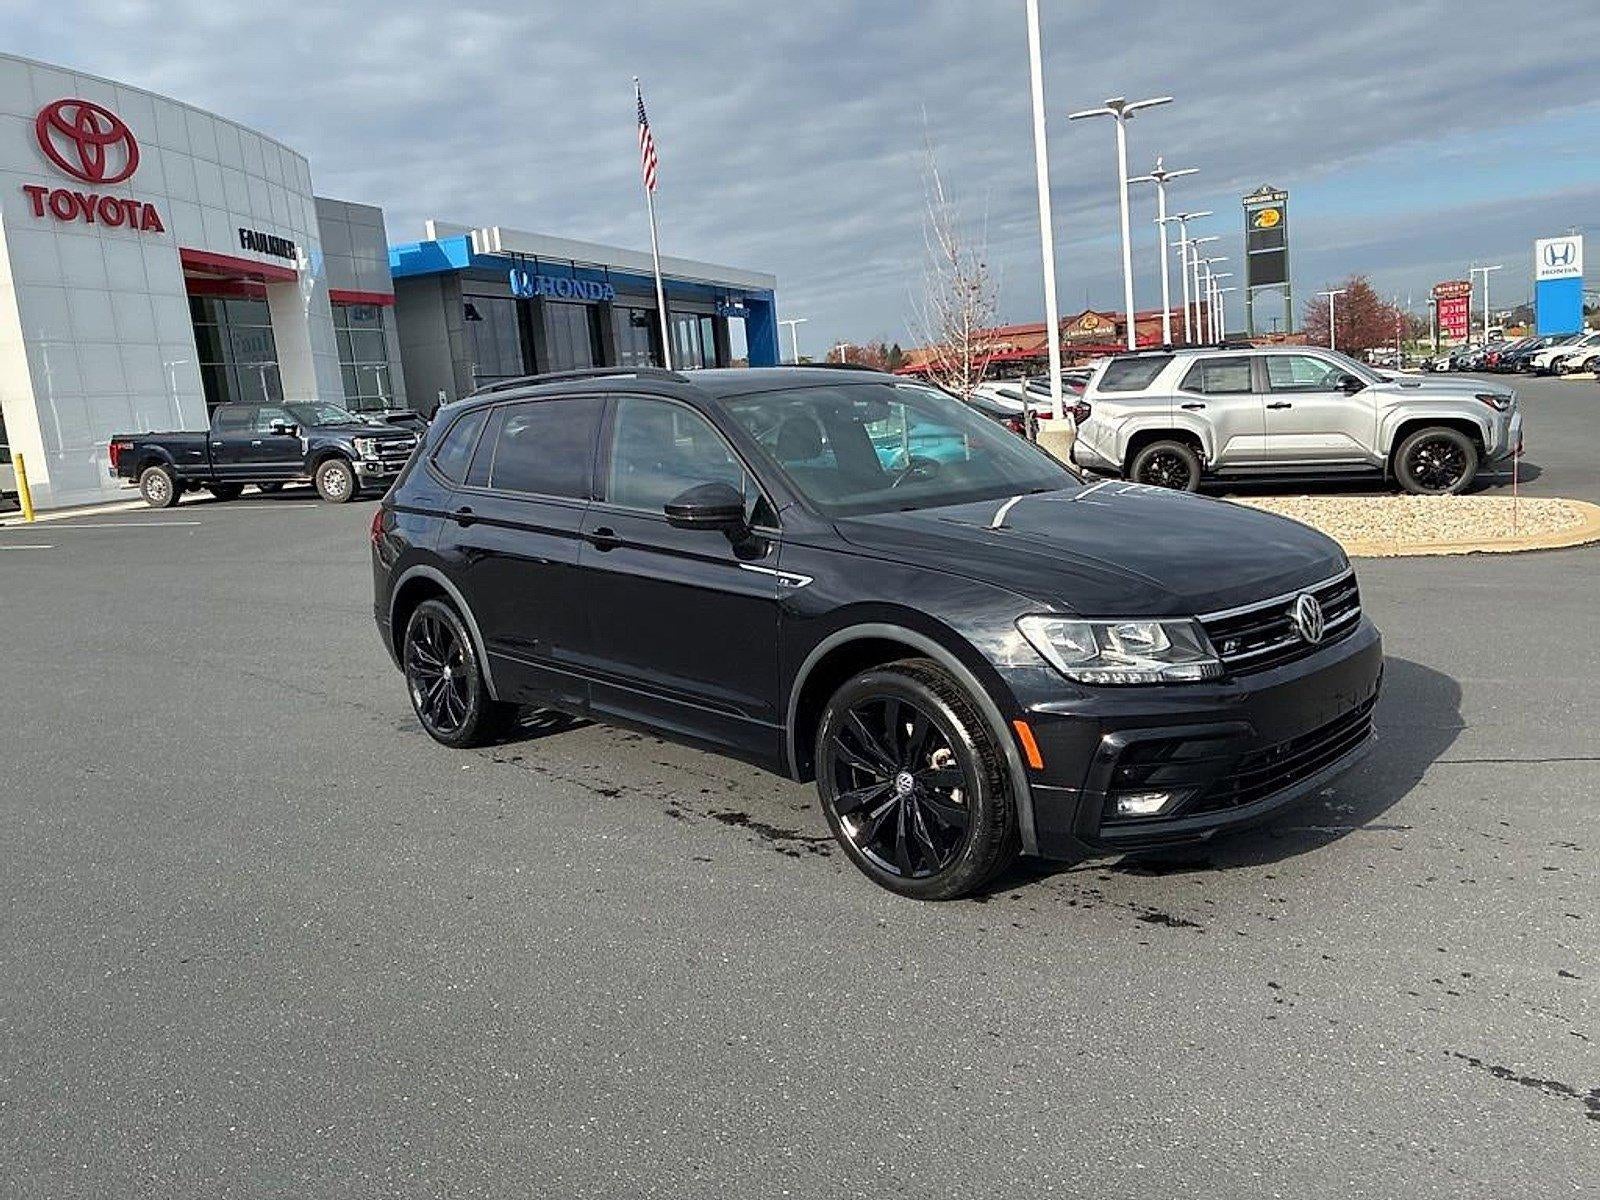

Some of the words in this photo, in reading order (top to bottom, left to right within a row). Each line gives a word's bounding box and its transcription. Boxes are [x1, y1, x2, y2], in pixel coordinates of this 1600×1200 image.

[23, 184, 165, 233] TOYOTA
[1541, 266, 1578, 276] HONDA
[536, 275, 614, 300] HONDA
